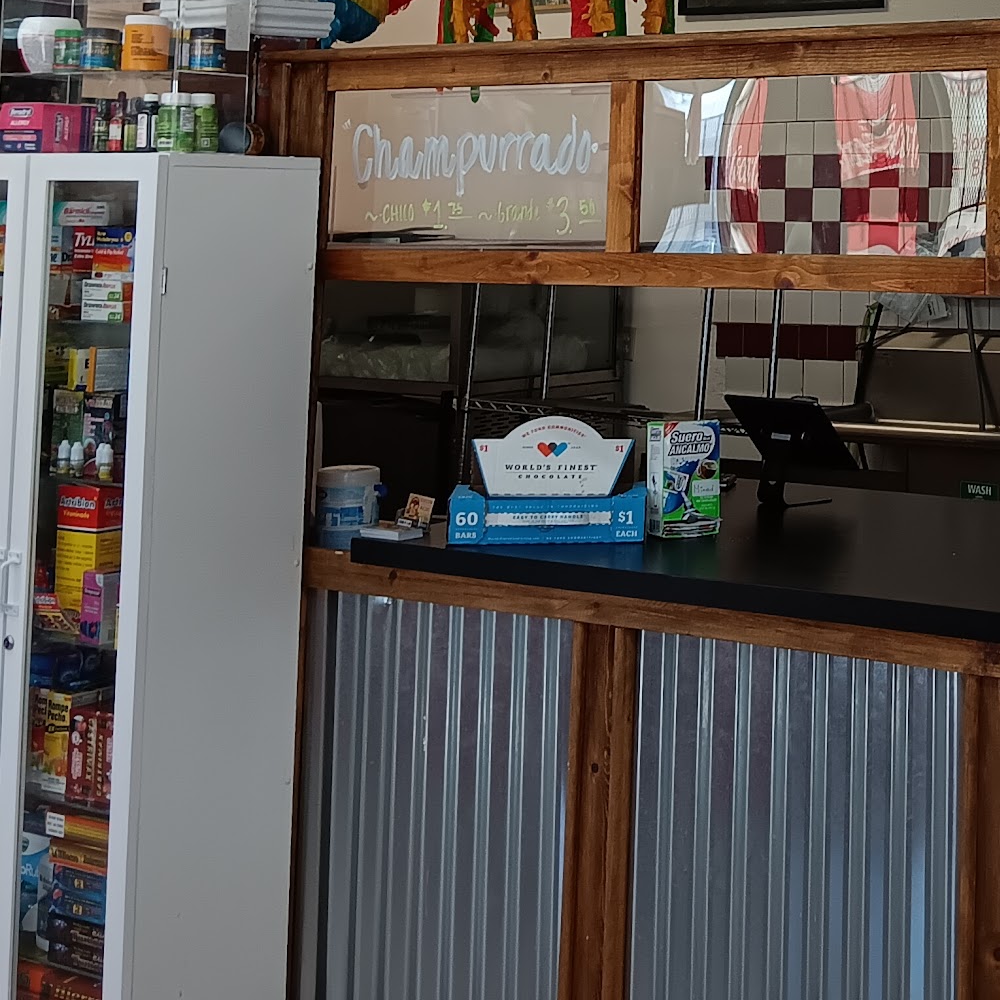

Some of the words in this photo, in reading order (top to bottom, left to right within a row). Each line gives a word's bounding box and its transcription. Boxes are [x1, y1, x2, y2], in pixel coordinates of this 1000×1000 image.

[670, 431, 704, 444] Suero
[479, 444, 488, 453] $1
[615, 444, 624, 453] $1
[668, 443, 711, 456] ANCALMO
[967, 484, 992, 496] WASH
[455, 511, 479, 526] 60
[618, 510, 634, 526] $1
[455, 531, 477, 539] BARS
[615, 530, 638, 538] EACH
[48, 699, 69, 713] Rompe
[47, 710, 66, 722] Pecho
